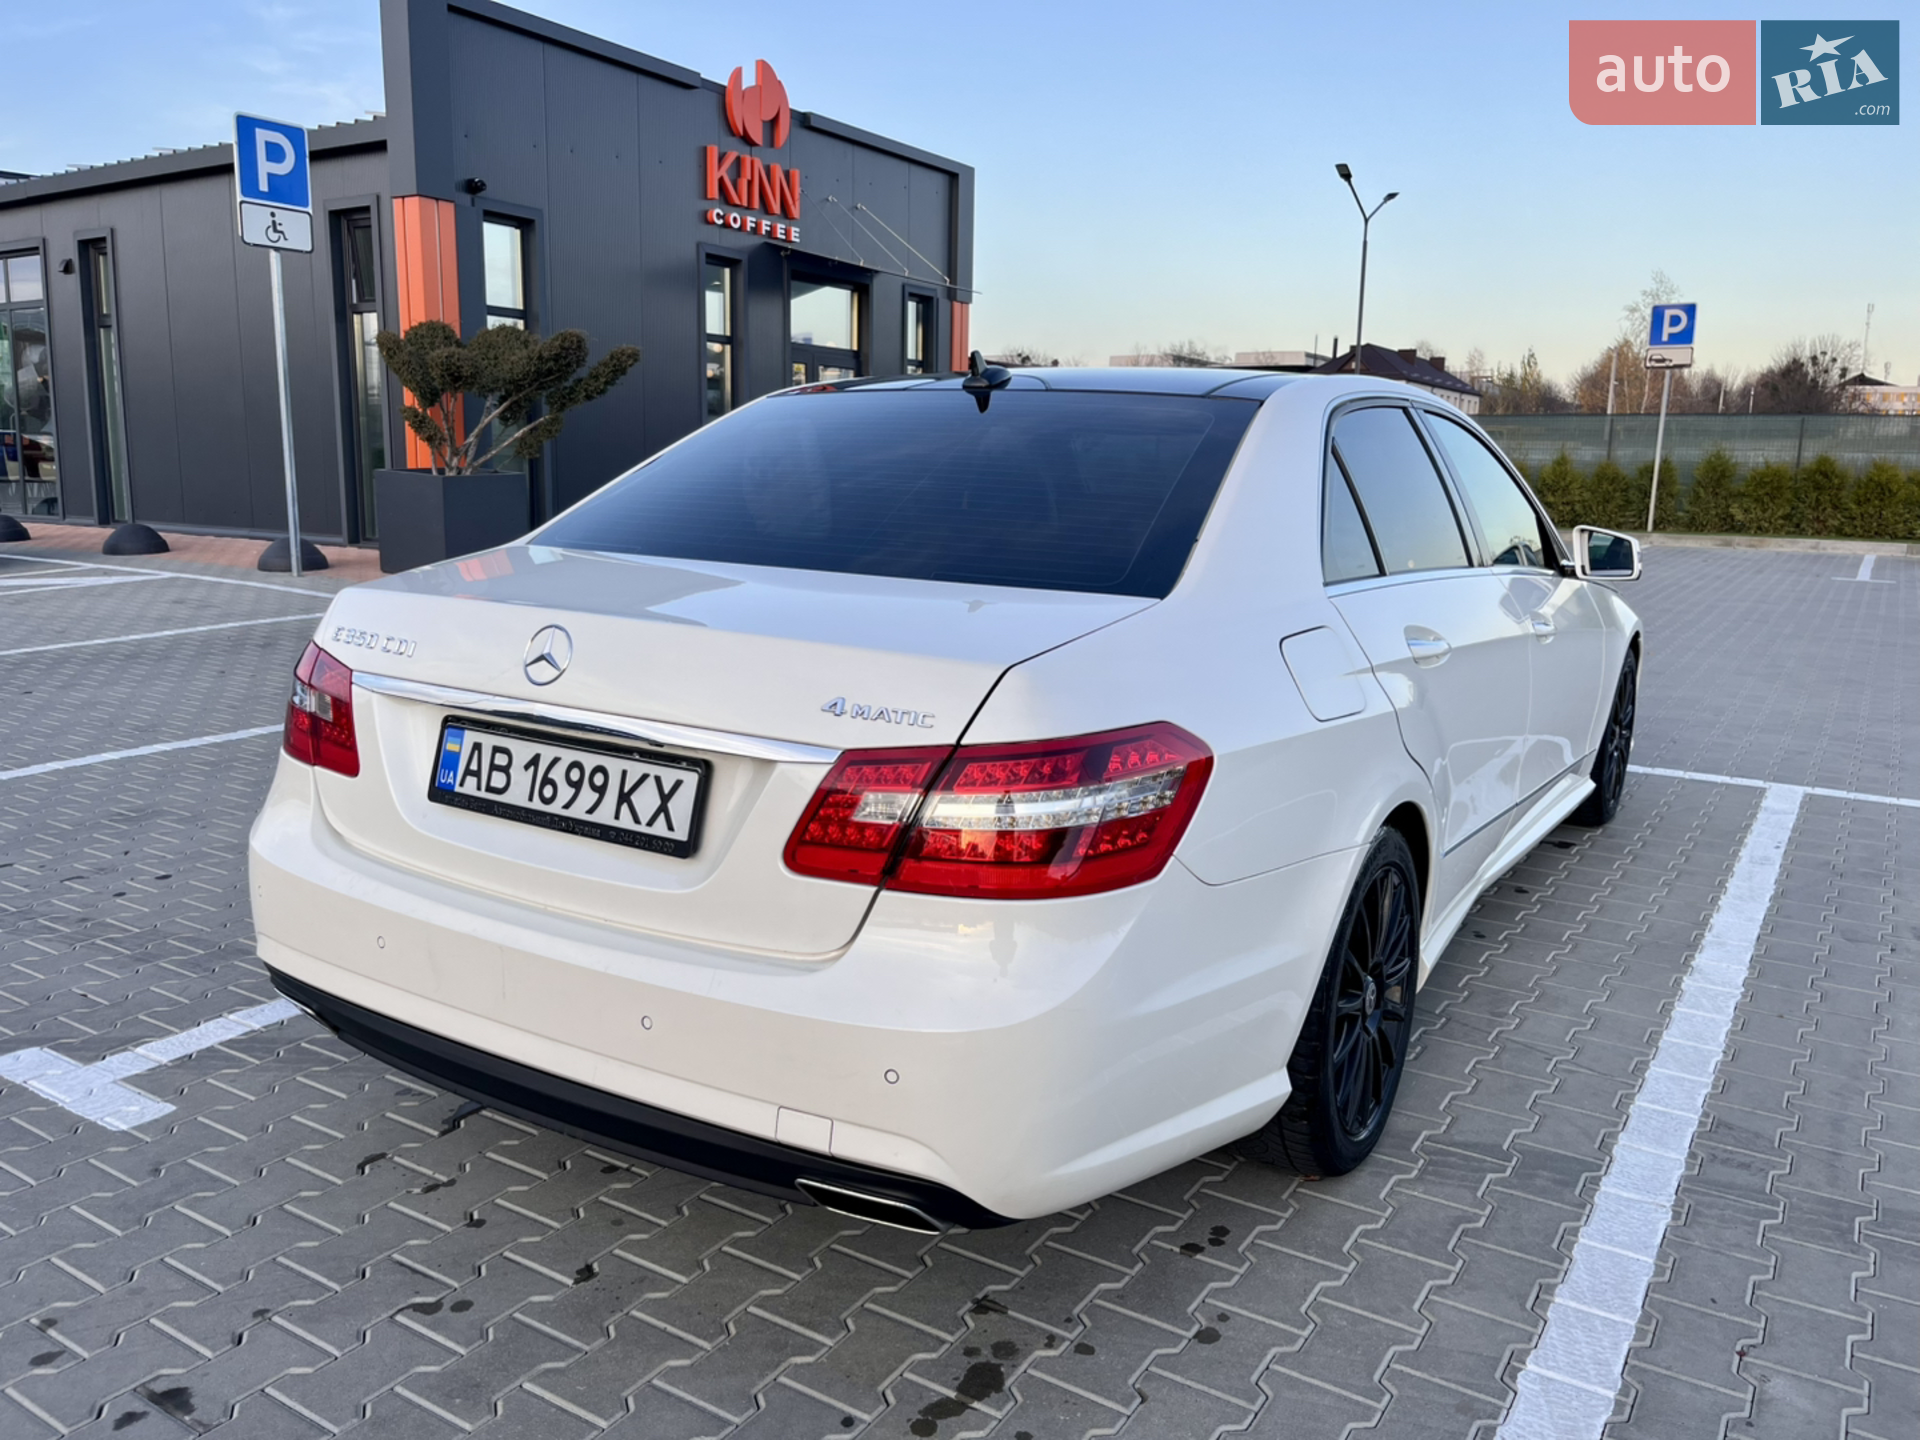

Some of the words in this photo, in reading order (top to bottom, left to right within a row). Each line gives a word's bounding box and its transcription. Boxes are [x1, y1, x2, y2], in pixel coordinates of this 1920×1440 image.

[255, 127, 296, 193] P
[705, 144, 800, 219] KINN
[707, 208, 800, 243] COFFEE
[1661, 308, 1688, 342] P
[380, 635, 417, 658] CDI
[439, 768, 455, 786] UA
[523, 752, 610, 815] 1699
